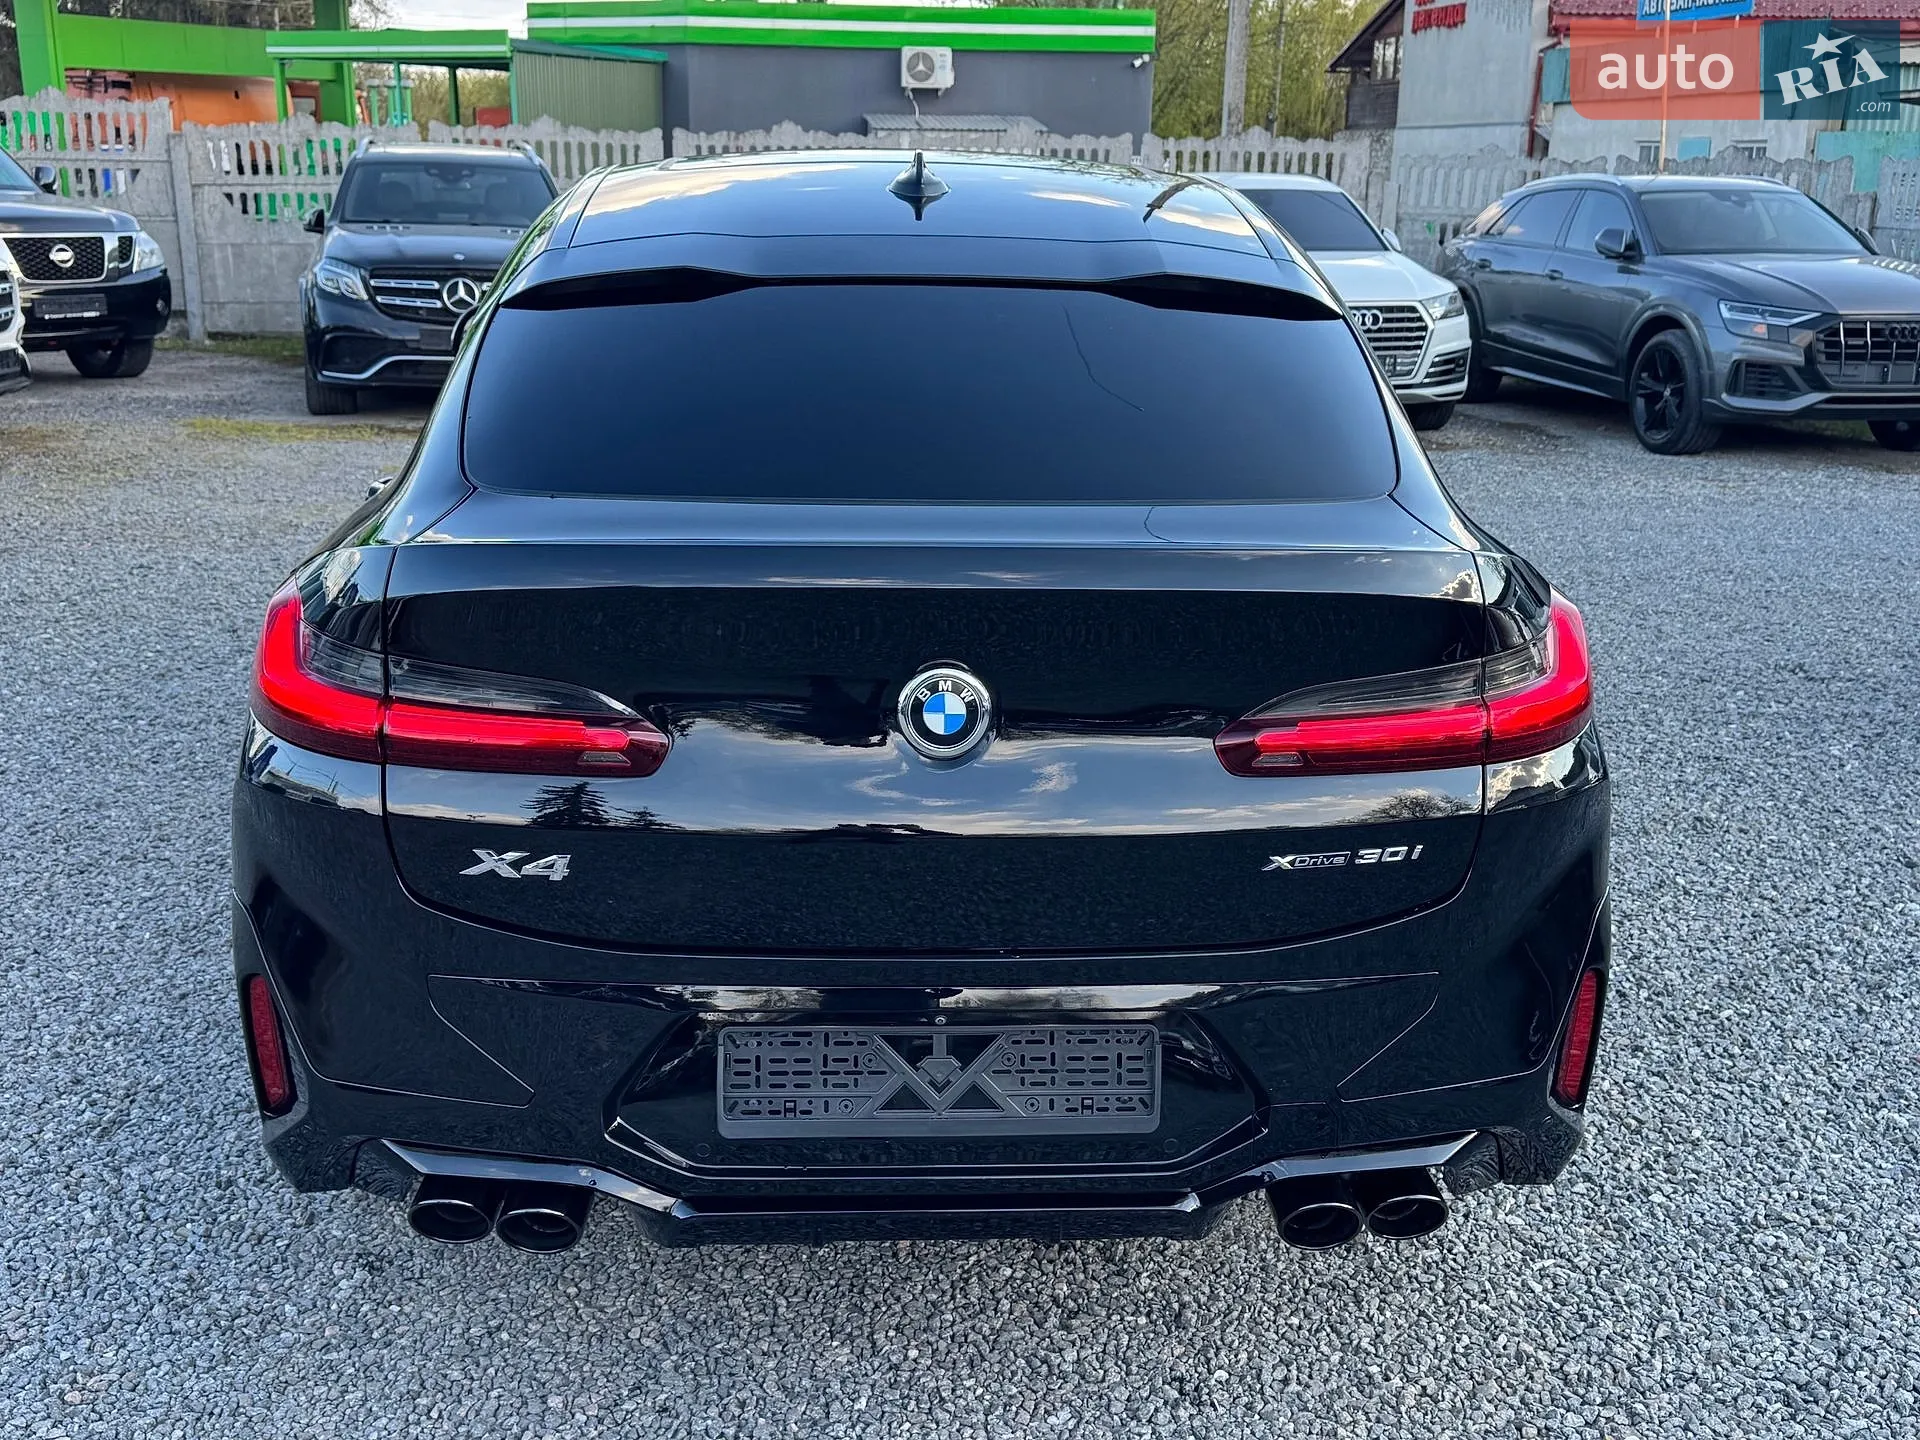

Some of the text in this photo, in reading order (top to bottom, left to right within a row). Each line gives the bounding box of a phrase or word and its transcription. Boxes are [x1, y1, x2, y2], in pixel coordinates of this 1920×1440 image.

[916, 680, 975, 703] BMW
[458, 848, 572, 881] X4
[1355, 844, 1424, 865] 30i
